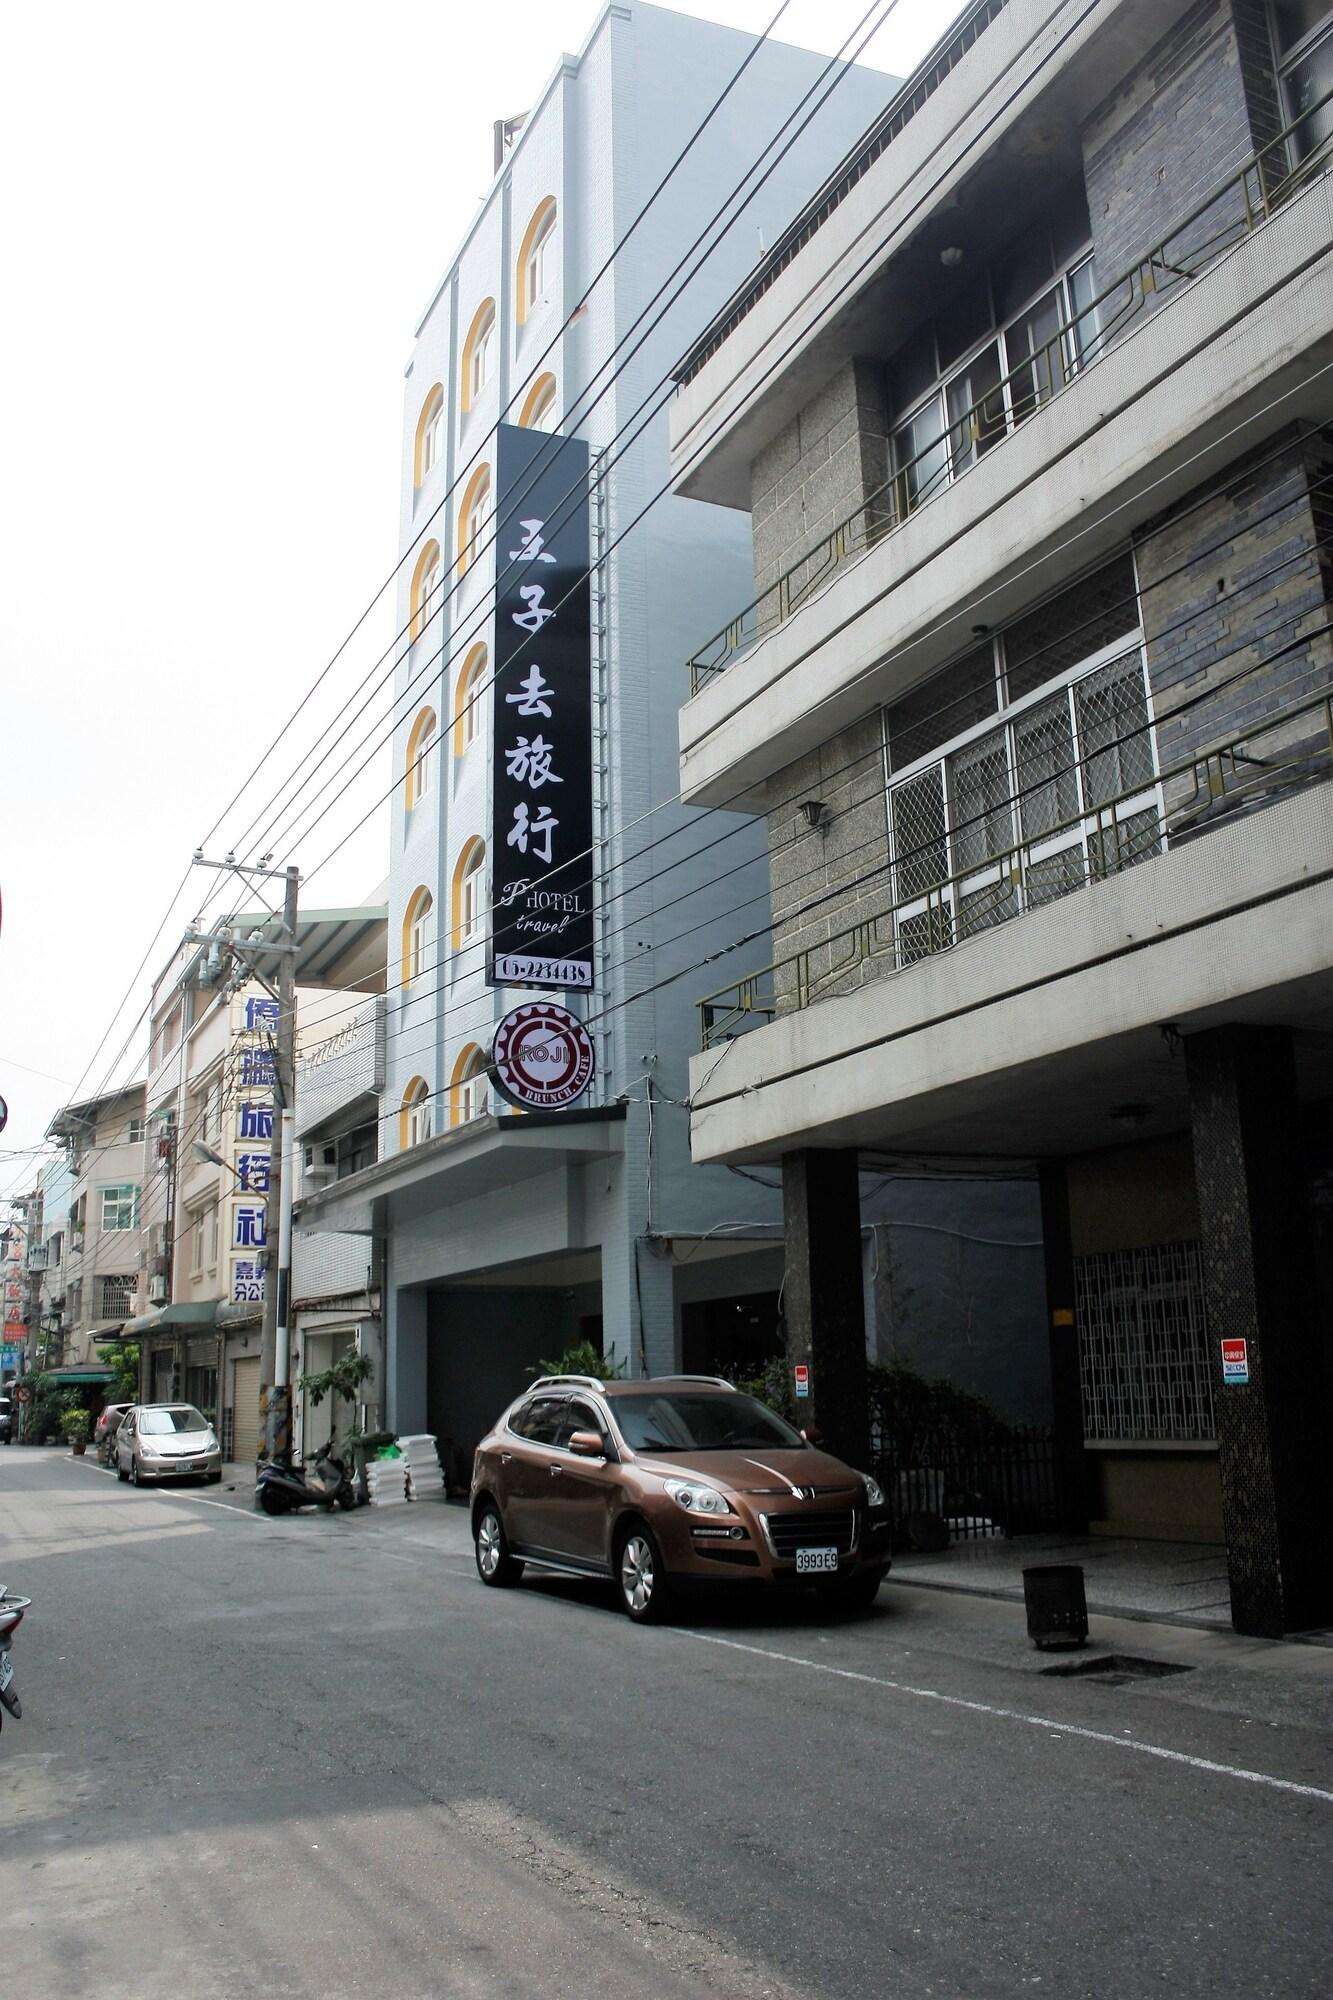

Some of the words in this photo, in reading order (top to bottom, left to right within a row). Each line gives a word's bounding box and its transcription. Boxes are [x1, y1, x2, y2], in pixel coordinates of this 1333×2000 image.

[516, 914, 570, 934] travel
[575, 1055, 590, 1086] CAFE
[235, 1283, 264, 1301] 分公
